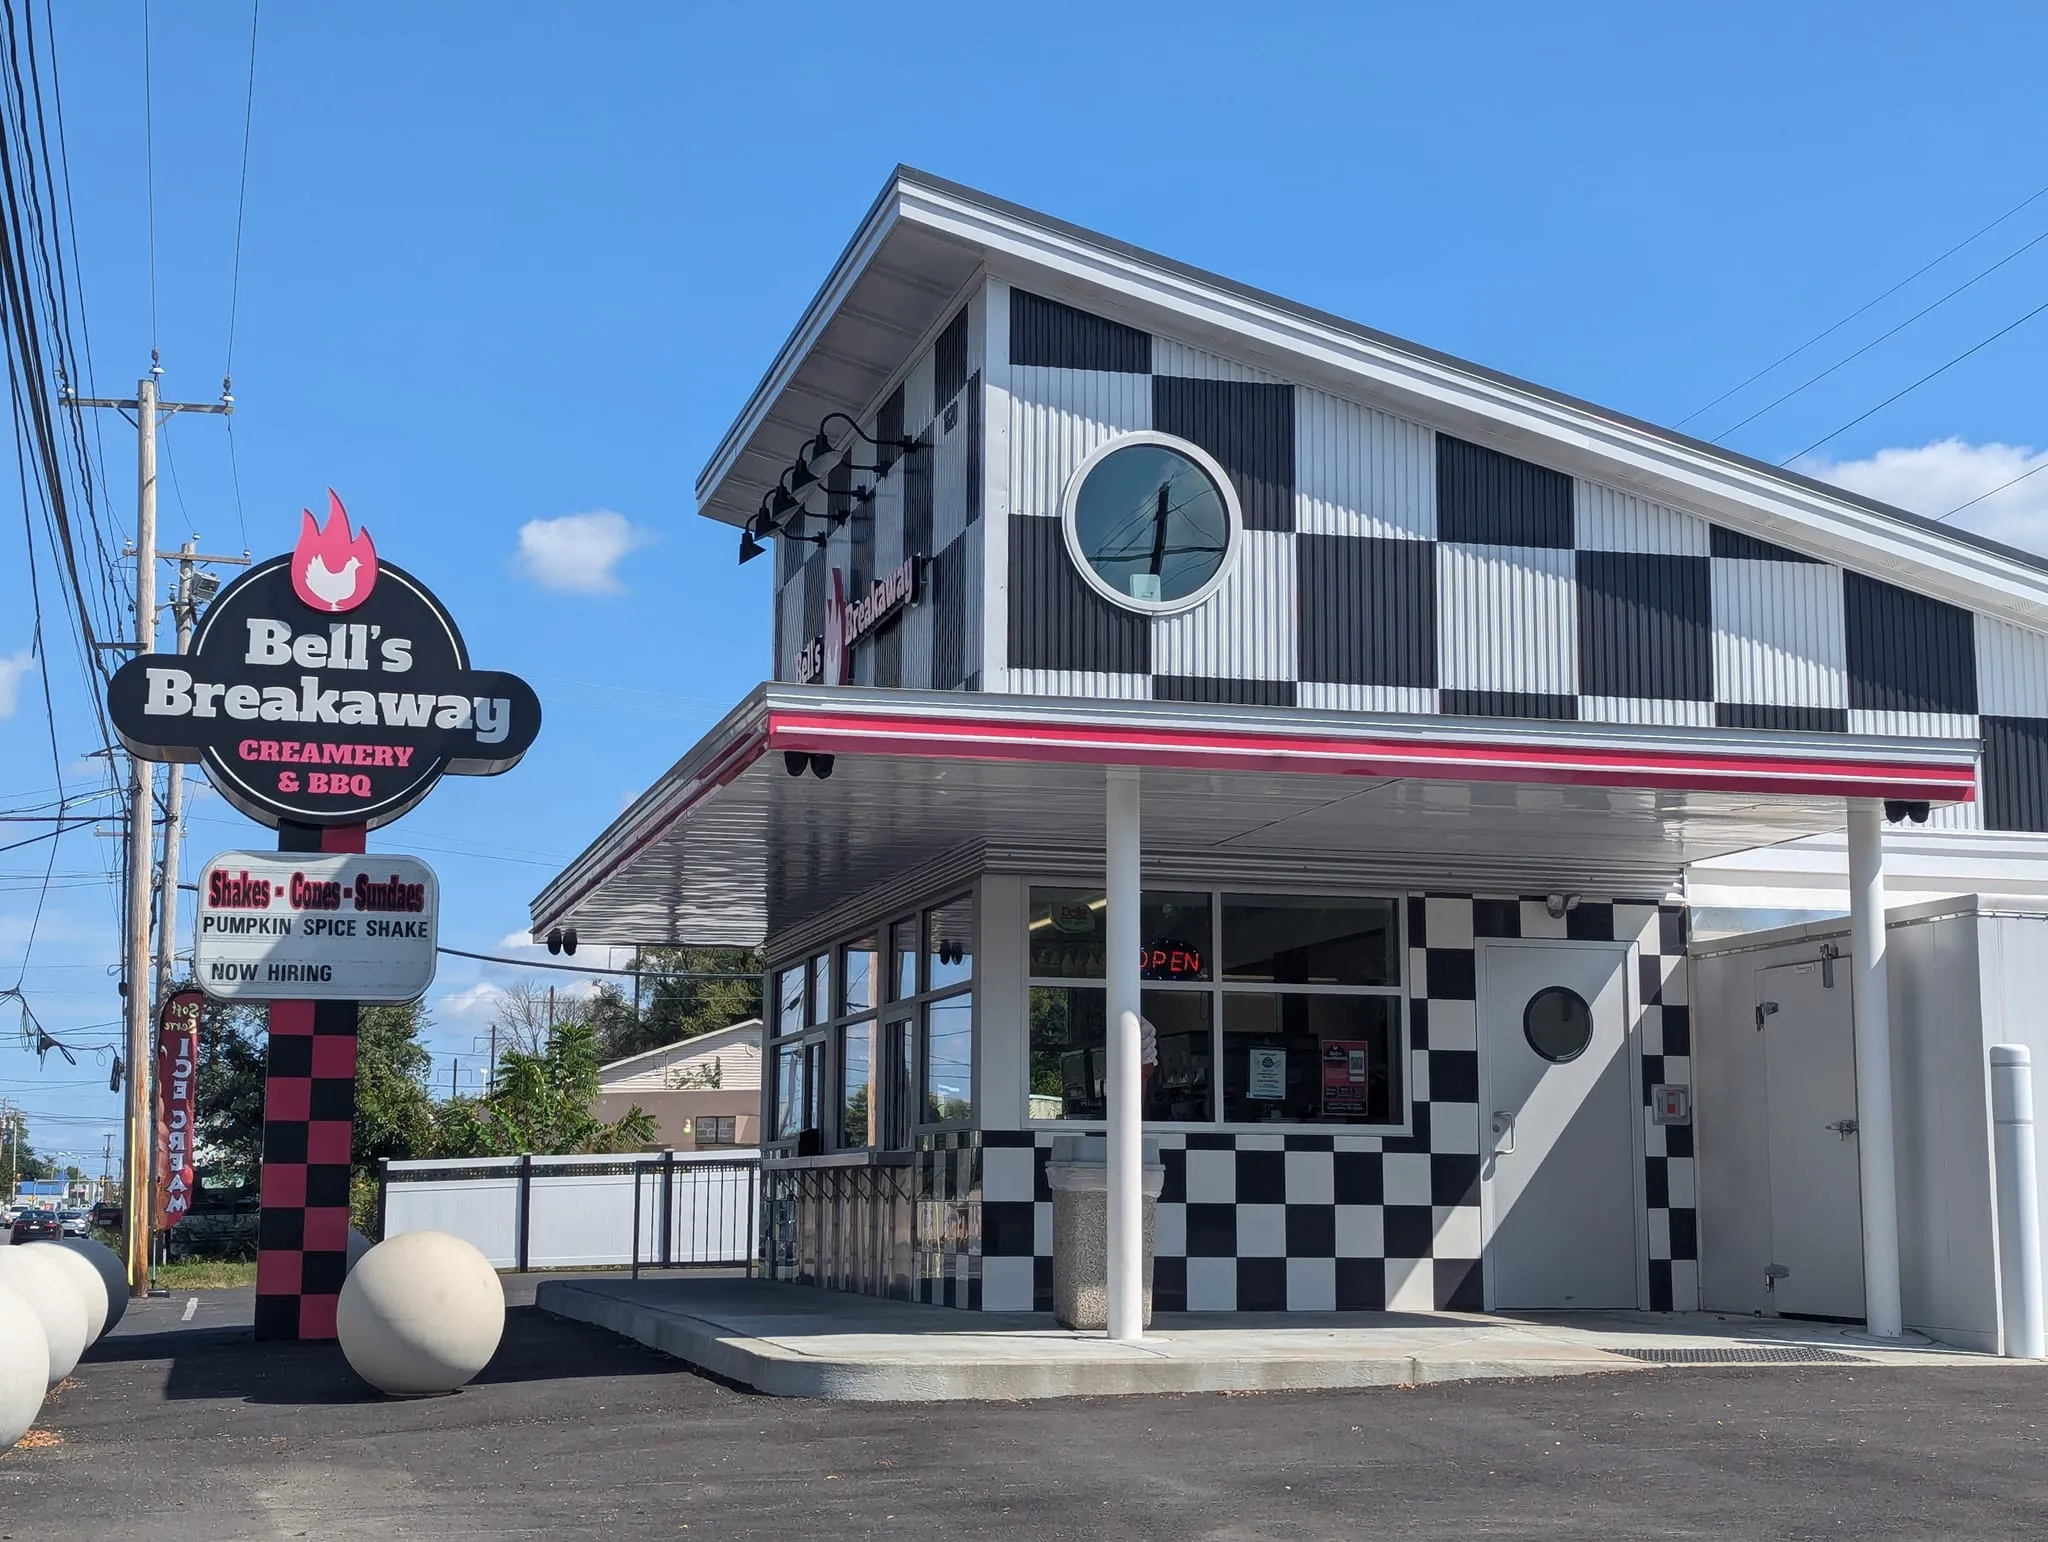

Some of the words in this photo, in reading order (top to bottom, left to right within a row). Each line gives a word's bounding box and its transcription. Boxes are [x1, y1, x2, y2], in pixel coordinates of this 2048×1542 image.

[845, 556, 913, 647] Breakaway
[245, 618, 413, 673] Bell's
[144, 668, 511, 744] Breakaway
[238, 740, 415, 767] CREAMERY
[277, 771, 300, 794] &
[308, 772, 372, 797] BBQ
[208, 869, 272, 910] Shakes
[290, 871, 342, 911] Cones
[354, 872, 426, 913] Sundaes
[203, 916, 292, 935] PUMPKIN
[303, 919, 357, 937] SPICE
[366, 920, 429, 939] SHAKE
[211, 963, 259, 981] NOW
[268, 964, 332, 982] HIRING
